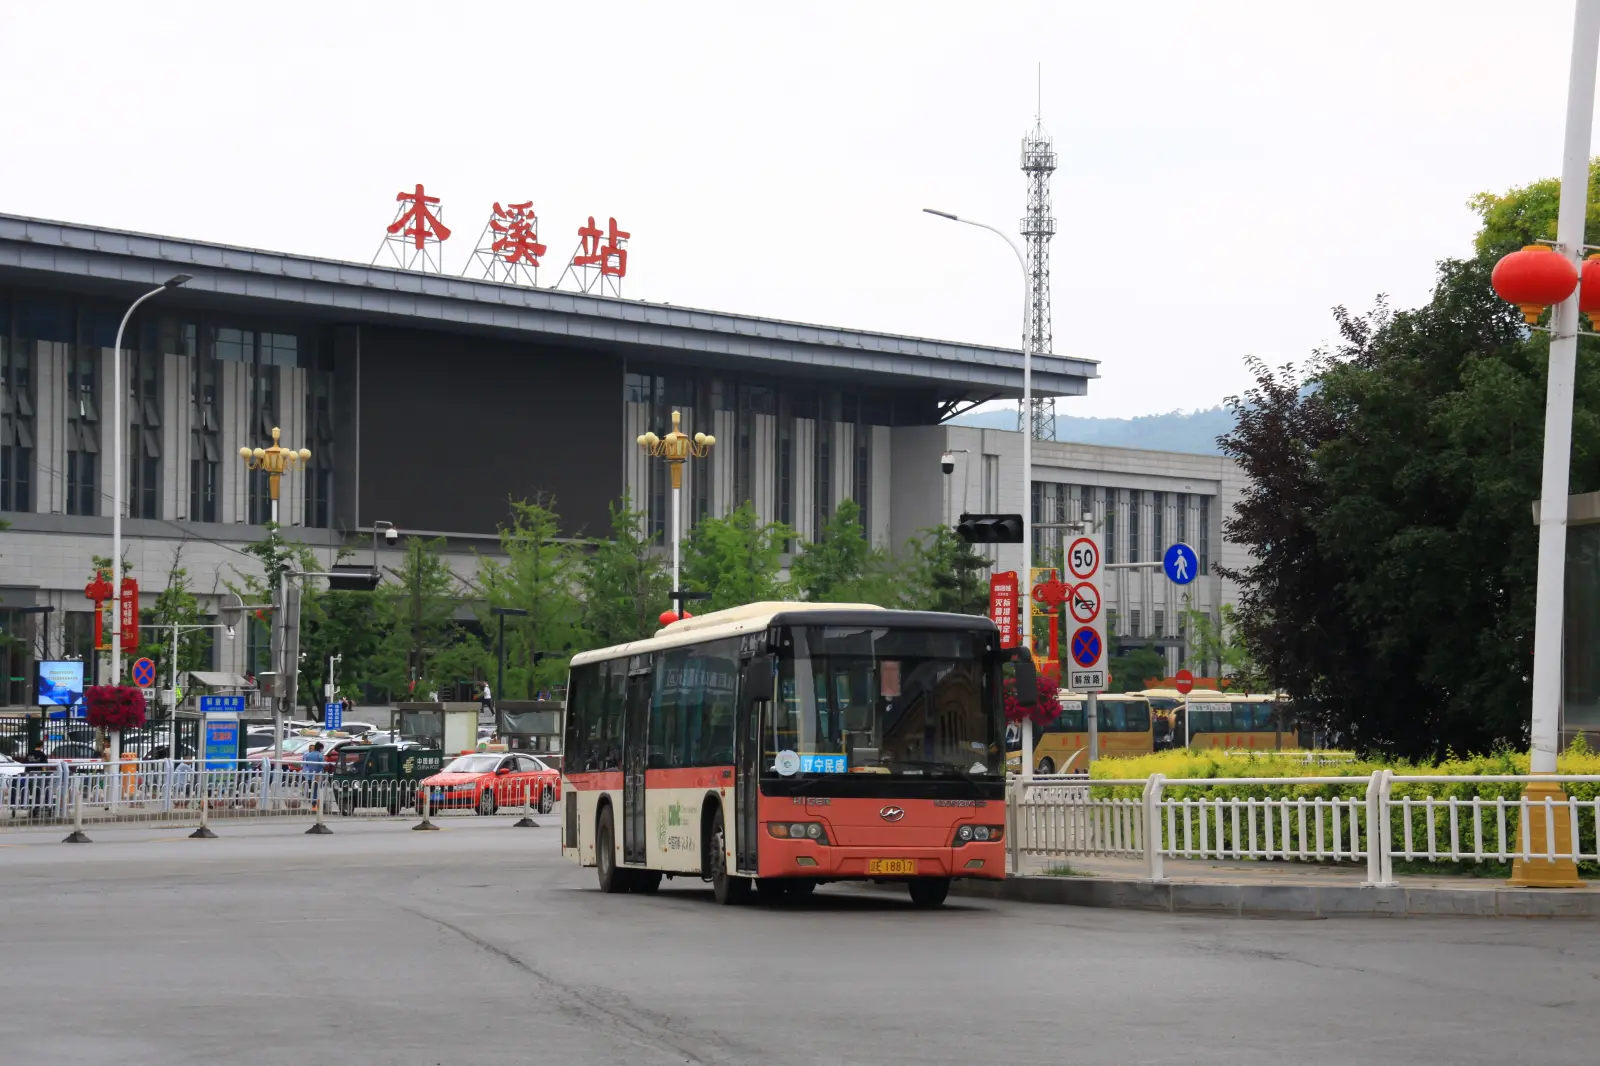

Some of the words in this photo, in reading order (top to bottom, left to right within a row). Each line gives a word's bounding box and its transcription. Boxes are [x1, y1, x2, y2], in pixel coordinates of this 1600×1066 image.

[386, 183, 630, 277] 本溪站
[1074, 549, 1093, 568] 50
[1075, 674, 1100, 685] 解放路
